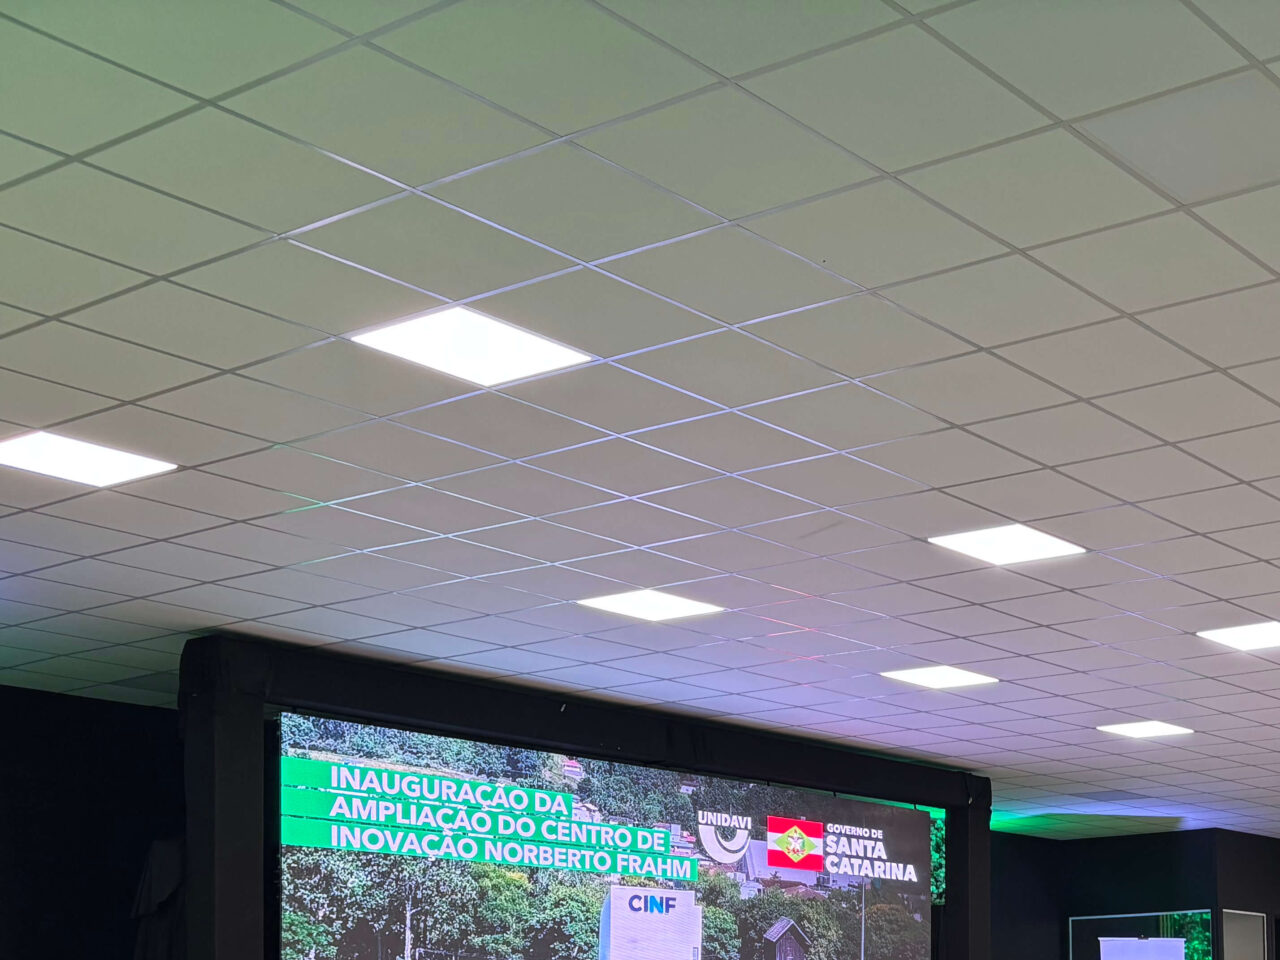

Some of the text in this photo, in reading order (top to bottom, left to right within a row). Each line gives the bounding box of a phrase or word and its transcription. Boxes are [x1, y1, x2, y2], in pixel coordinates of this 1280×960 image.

[331, 766, 568, 815] INAUGURAÇÃO DA
[329, 796, 665, 851] AMPLIAÇÃO DO CENTRO DE
[698, 810, 752, 830] UNIDAVI
[826, 823, 883, 839] GOVERNO DE
[331, 825, 691, 878] INOVAÇÃO NORBERTO FRAHM
[825, 836, 887, 860] SANTA
[825, 858, 918, 882] CATARINA
[628, 894, 676, 914] CINF
